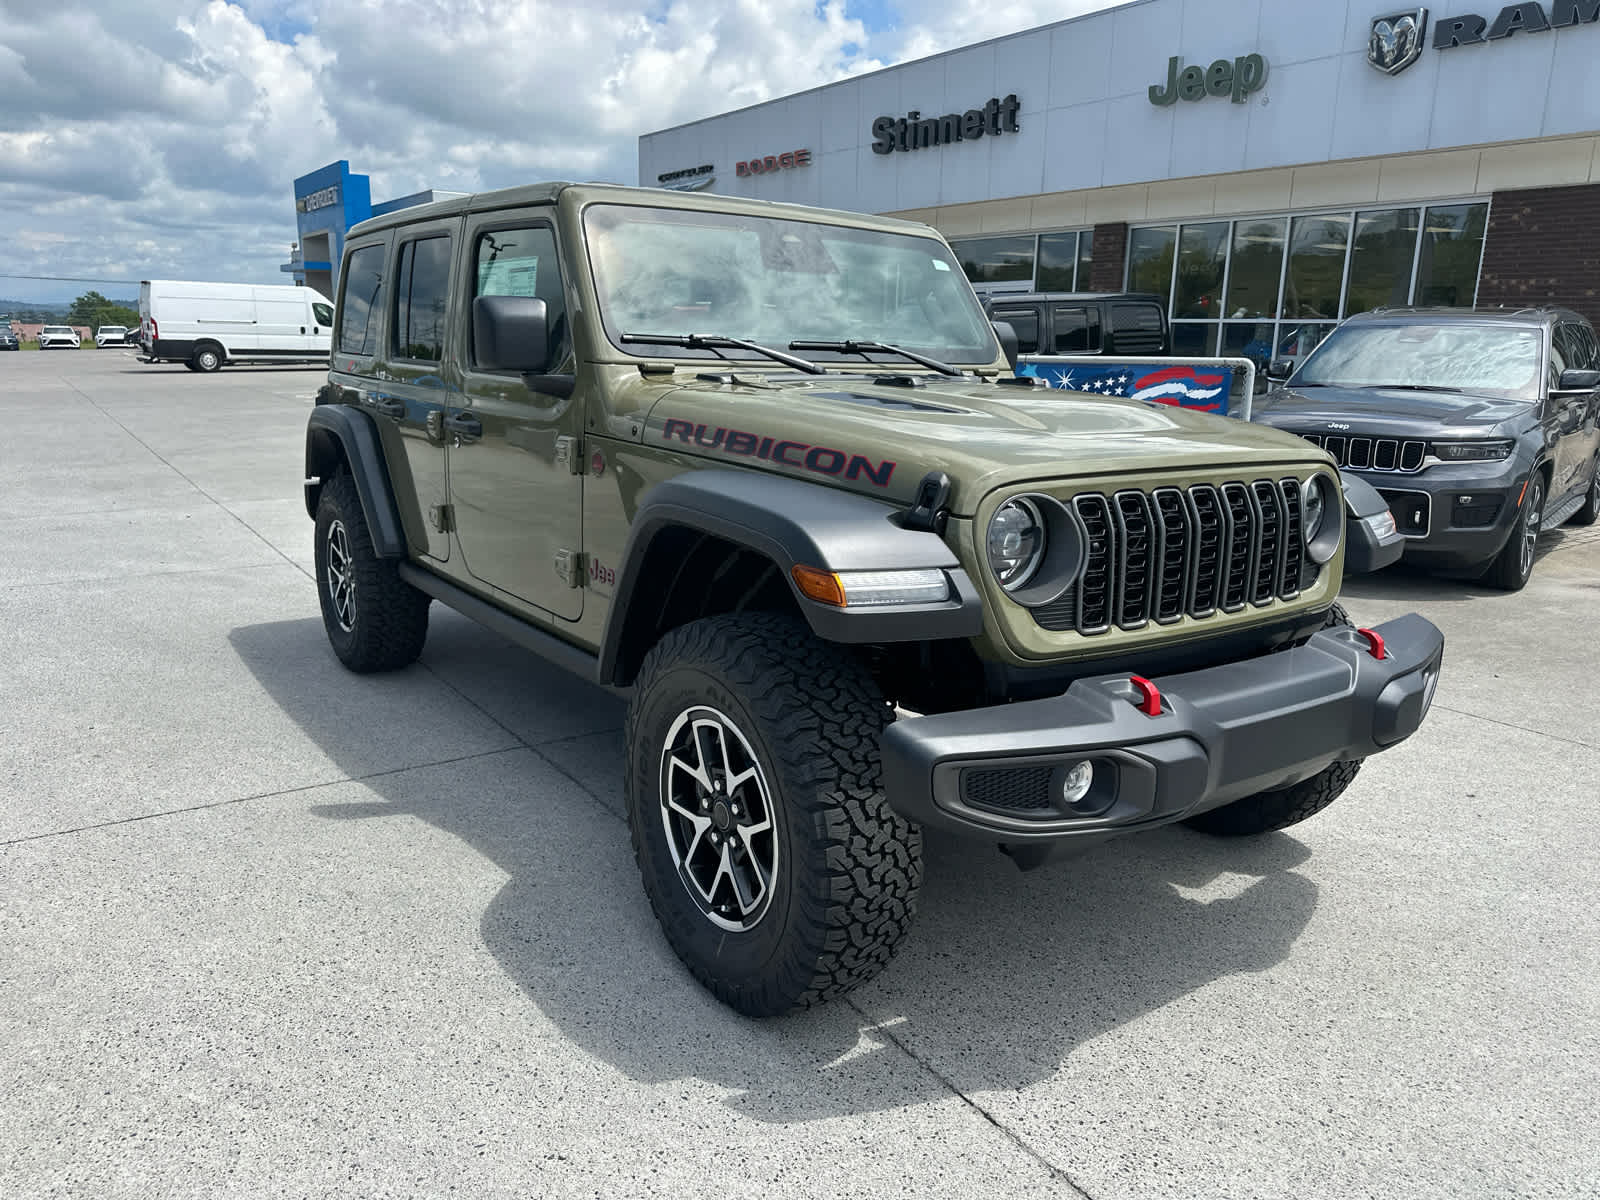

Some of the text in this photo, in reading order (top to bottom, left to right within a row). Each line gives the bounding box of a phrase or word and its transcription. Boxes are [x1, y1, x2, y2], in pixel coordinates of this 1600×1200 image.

[1149, 53, 1267, 106] Jeep
[872, 94, 1020, 155] Stinnett
[736, 150, 811, 177] DODGE
[1327, 422, 1350, 430] Jeep
[663, 418, 897, 488] RUBICON
[589, 558, 616, 586] Jee
